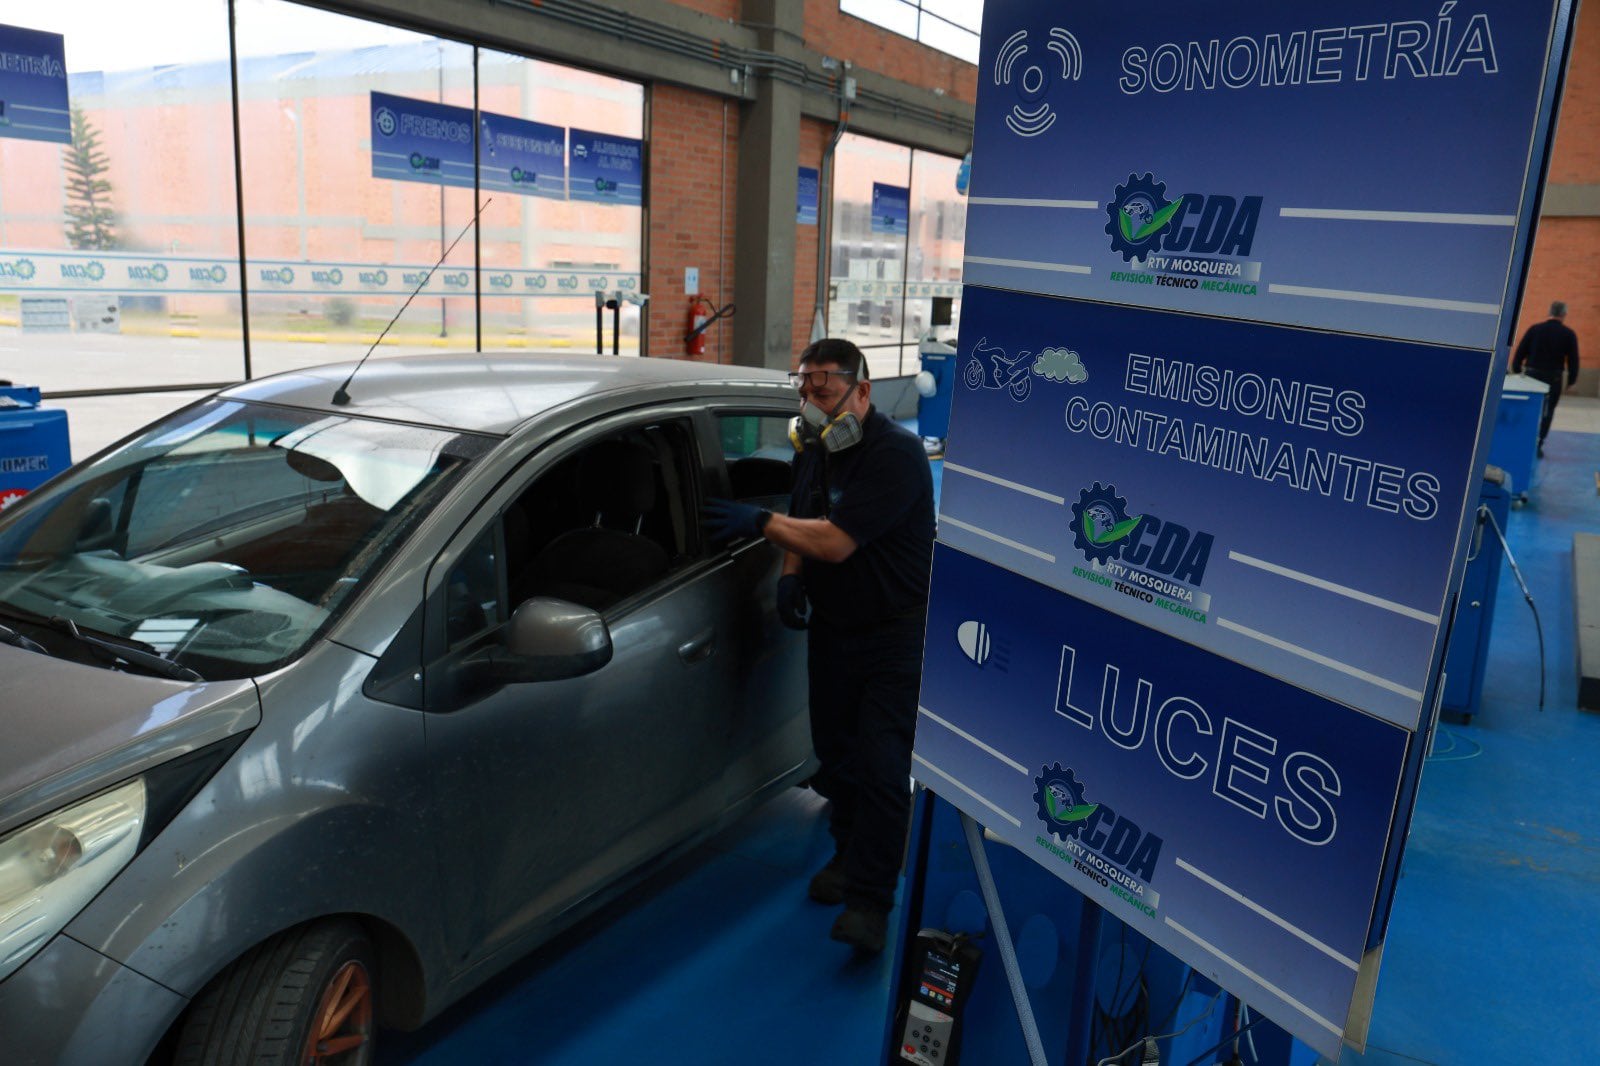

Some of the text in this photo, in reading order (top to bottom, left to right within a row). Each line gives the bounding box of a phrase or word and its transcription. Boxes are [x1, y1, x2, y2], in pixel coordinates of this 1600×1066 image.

[1119, 1, 1499, 95] SONOMETRÍA
[400, 113, 471, 144] FRENOS
[1163, 193, 1264, 256] CDA
[1110, 271, 1257, 295] REVISIÓN TÉCNICO MECÁNICA
[1147, 257, 1242, 276] RTV MOSQUERA
[1124, 353, 1366, 437] EMISIONES
[1065, 396, 1441, 521] CONTAMINANTES
[1122, 513, 1215, 587] CDA
[1072, 566, 1207, 624] REVISIÓN TÉCNICO MECÁNICA
[1107, 562, 1193, 602] RTV MOSQUERA
[1054, 644, 1342, 846] LUCES
[1066, 840, 1144, 897] RTV MOSQUERA
[1080, 802, 1164, 884] CDA
